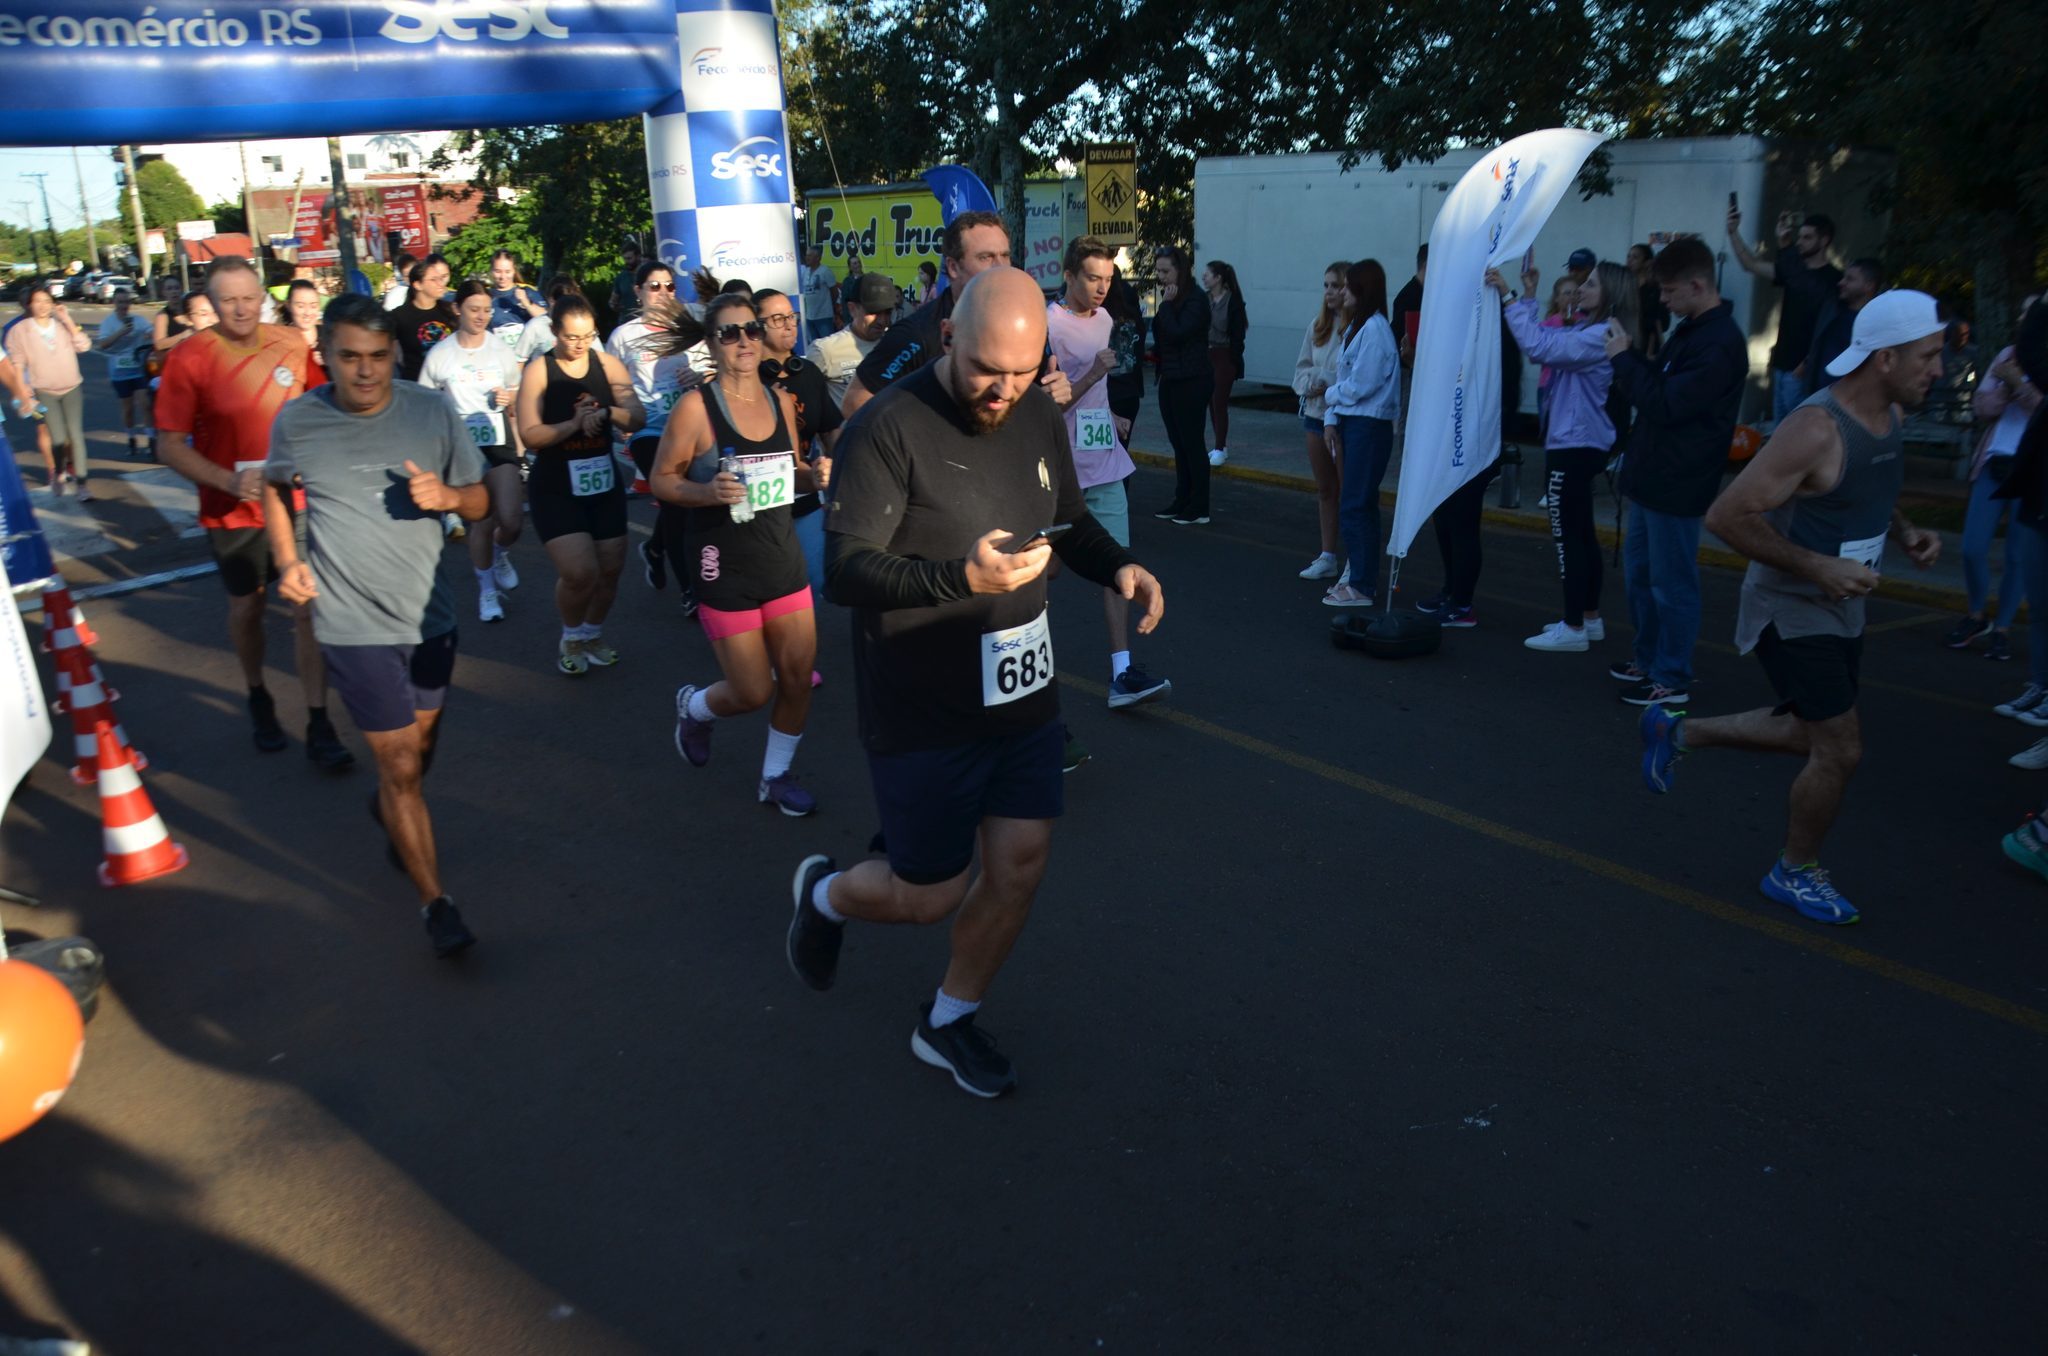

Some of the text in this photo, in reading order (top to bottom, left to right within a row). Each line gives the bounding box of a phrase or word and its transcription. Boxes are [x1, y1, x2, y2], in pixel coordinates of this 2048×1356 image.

[260, 9, 322, 46] RS
[710, 152, 782, 179] Sesc
[1089, 150, 1132, 160] DEVAGAR
[671, 165, 687, 176] RS
[815, 206, 878, 258] Food
[1092, 221, 1133, 235] ELEVADA
[1083, 423, 1113, 447] 348
[1452, 386, 1465, 467] Fecomércio
[579, 468, 612, 493] 567
[1548, 470, 1566, 538] GROWTH
[991, 638, 1022, 653] Sesc
[997, 640, 1049, 695] 683
